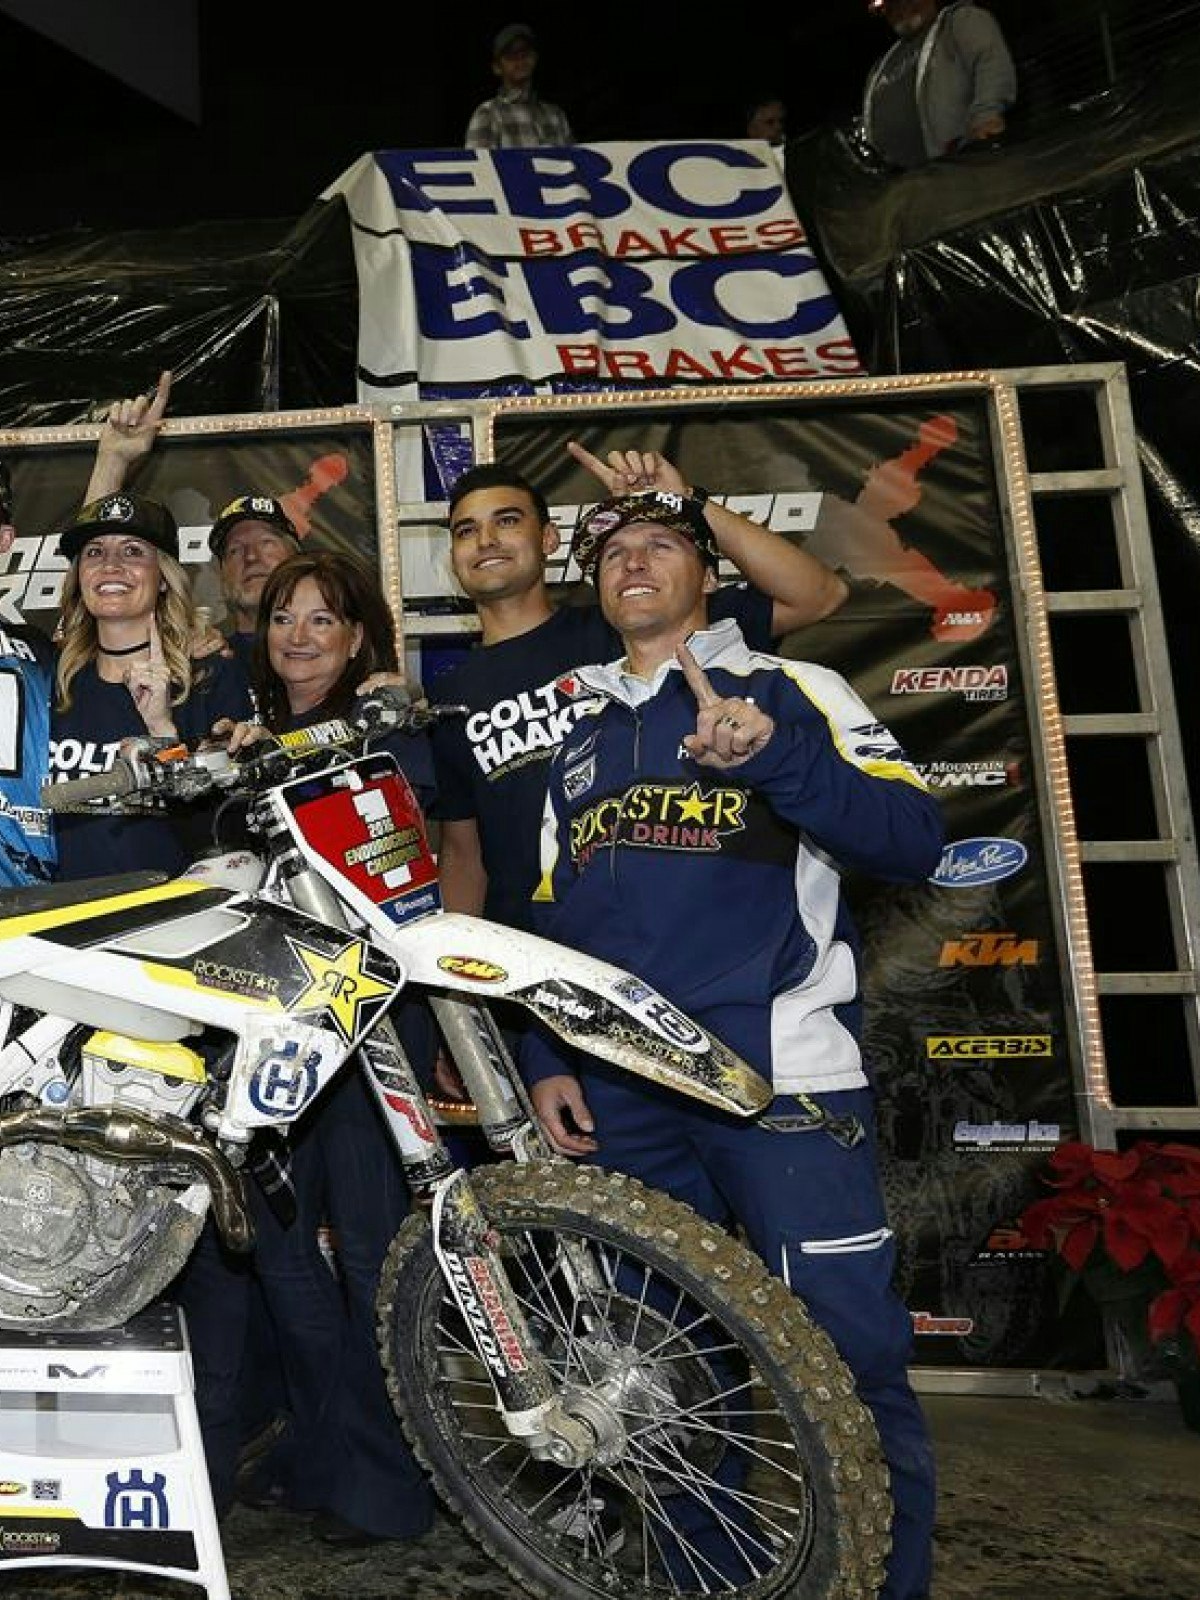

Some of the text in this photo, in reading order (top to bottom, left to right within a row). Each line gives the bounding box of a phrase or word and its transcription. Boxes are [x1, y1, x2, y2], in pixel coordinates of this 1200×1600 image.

[373, 143, 783, 219] EBC
[519, 219, 806, 258] BRAKES
[410, 243, 842, 340] EBC
[557, 339, 868, 378] BRAKES
[890, 665, 1007, 694] KENDA
[965, 689, 1007, 701] TIRES
[931, 761, 1004, 773] MOUNTAIN
[632, 822, 718, 847] DRINK
[939, 933, 1038, 967] KTM
[931, 1040, 1048, 1055] ACERBIS
[445, 1252, 508, 1378] DUNLOP
